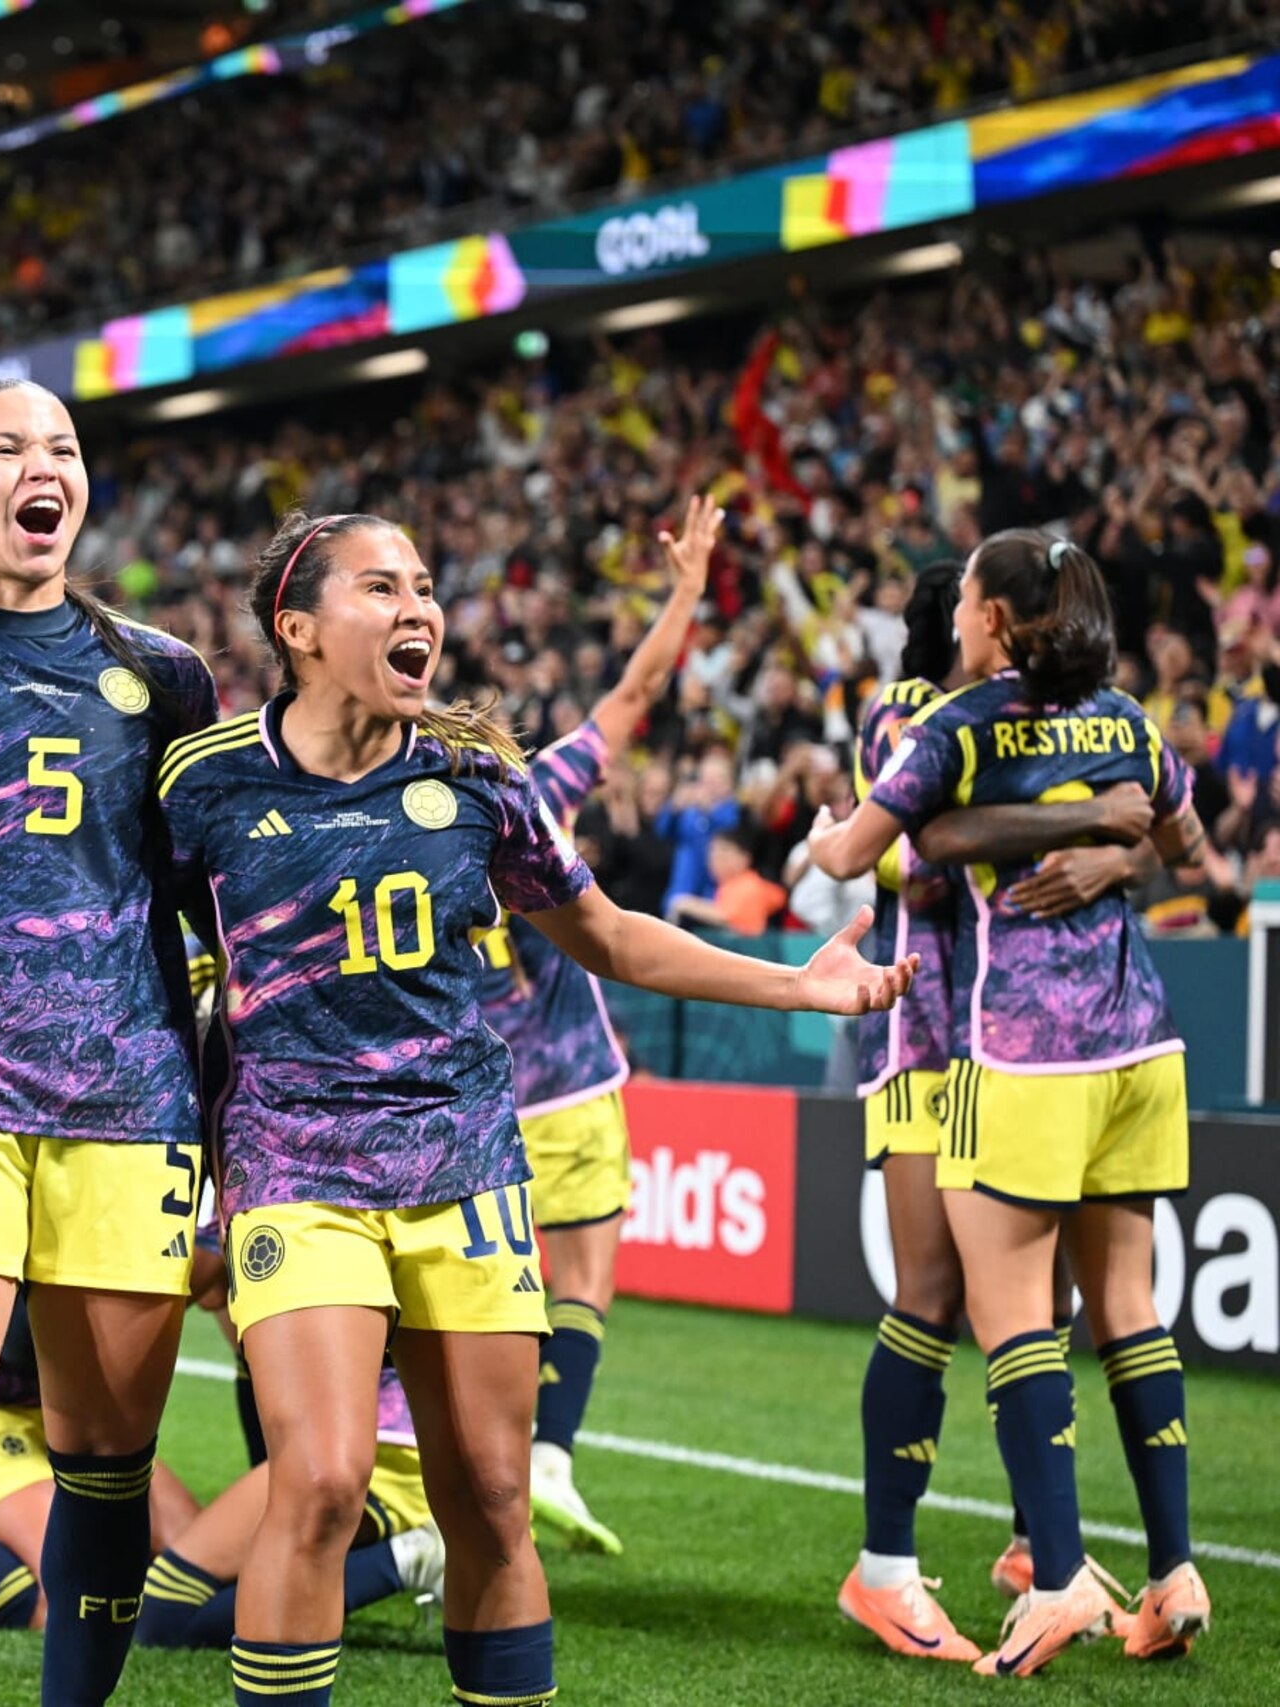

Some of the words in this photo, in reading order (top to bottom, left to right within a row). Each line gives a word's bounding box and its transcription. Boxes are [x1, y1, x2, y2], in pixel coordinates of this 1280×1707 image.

[595, 201, 710, 275] GOAL
[993, 717, 1136, 759] RESTREPO
[25, 738, 83, 835] 5
[328, 871, 435, 975] 10
[79, 1591, 144, 1624] FC
